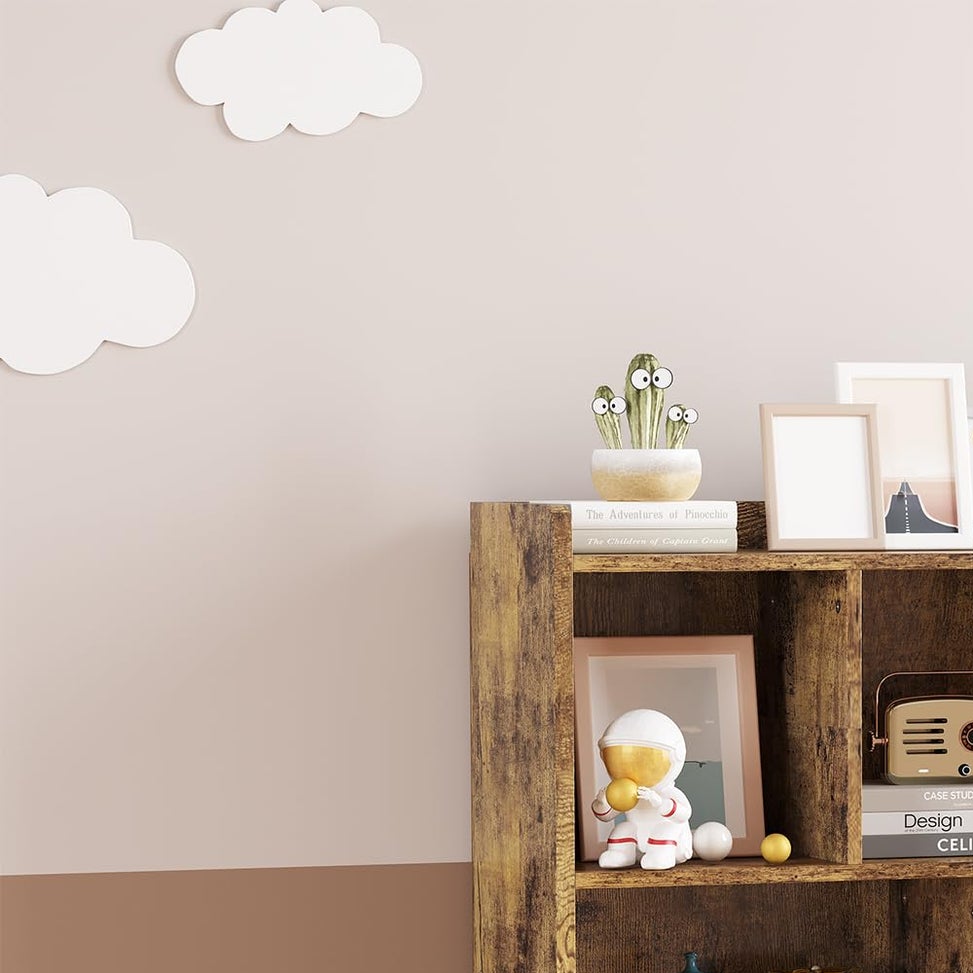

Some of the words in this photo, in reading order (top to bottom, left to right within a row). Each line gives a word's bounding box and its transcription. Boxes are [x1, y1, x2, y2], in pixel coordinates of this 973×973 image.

[586, 509, 604, 519] The
[609, 508, 663, 520] Adventures
[669, 509, 678, 519] of
[685, 509, 728, 519] Pinocchio
[607, 537, 647, 545] Children
[650, 538, 660, 547] of
[662, 537, 699, 546] Captain
[701, 537, 729, 545] Grant
[923, 791, 949, 800] CASE
[904, 813, 963, 832] Design
